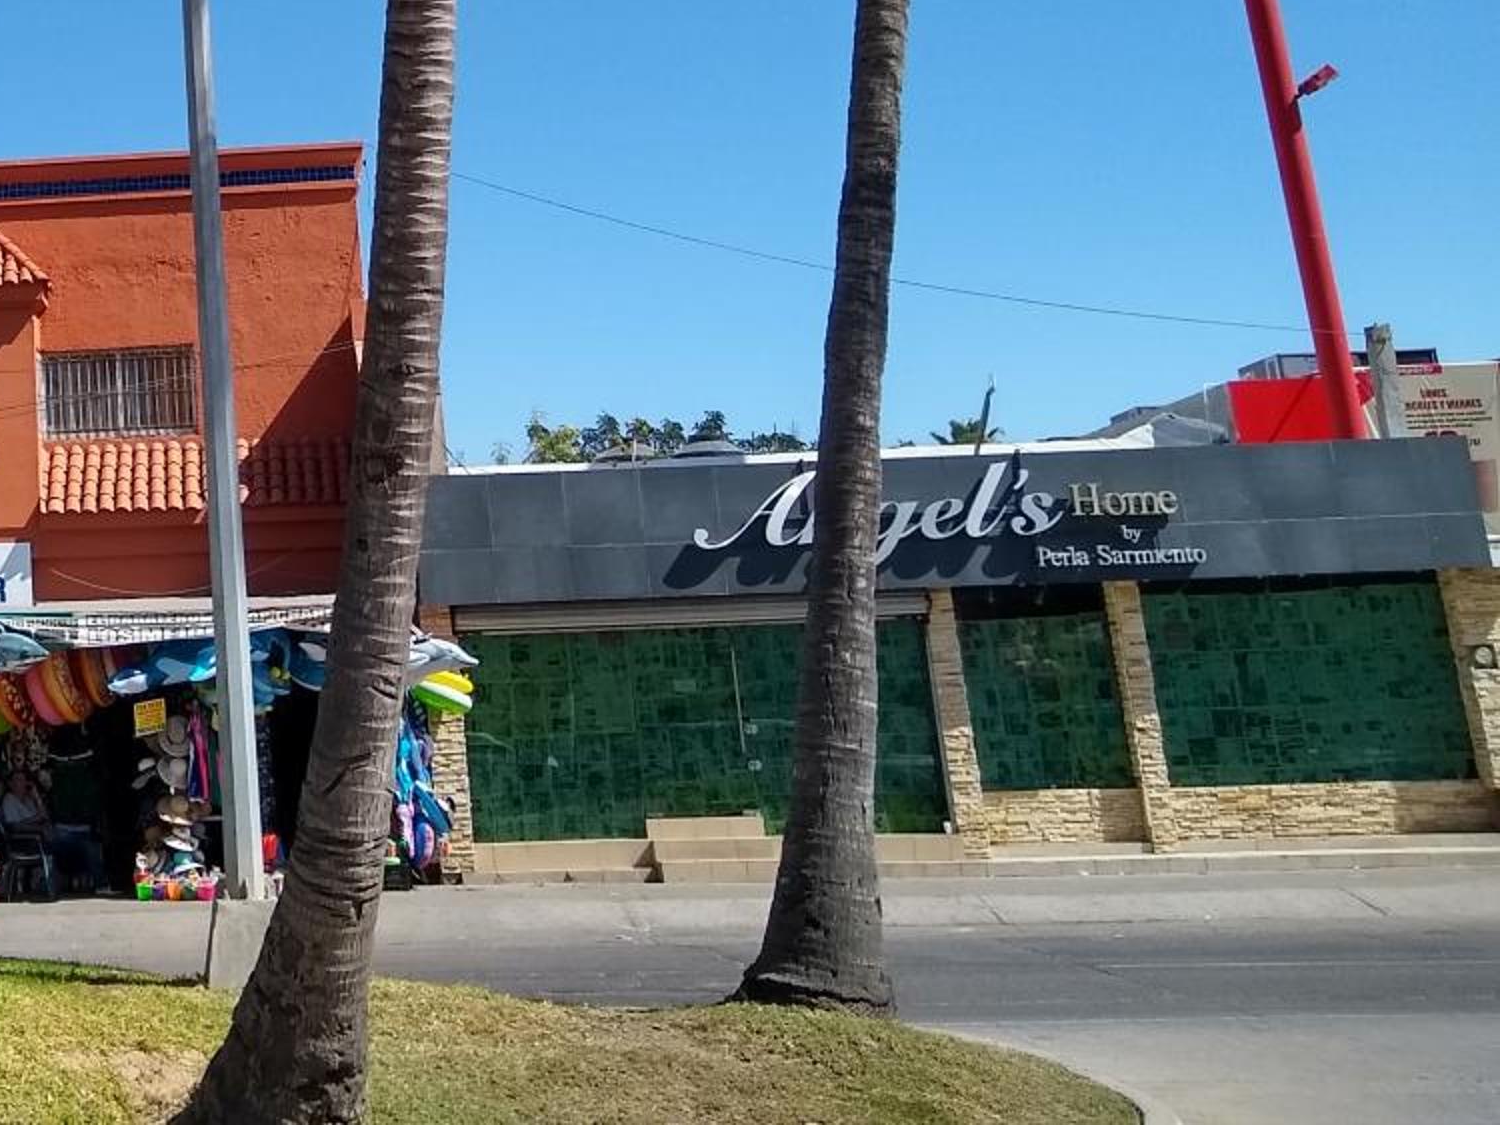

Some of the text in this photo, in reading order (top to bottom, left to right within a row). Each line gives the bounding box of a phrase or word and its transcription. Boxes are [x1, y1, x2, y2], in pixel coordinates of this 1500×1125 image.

[693, 461, 1179, 566] Agel's Home
[1120, 525, 1142, 543] by
[1037, 544, 1208, 567] Perla Sarmiento
